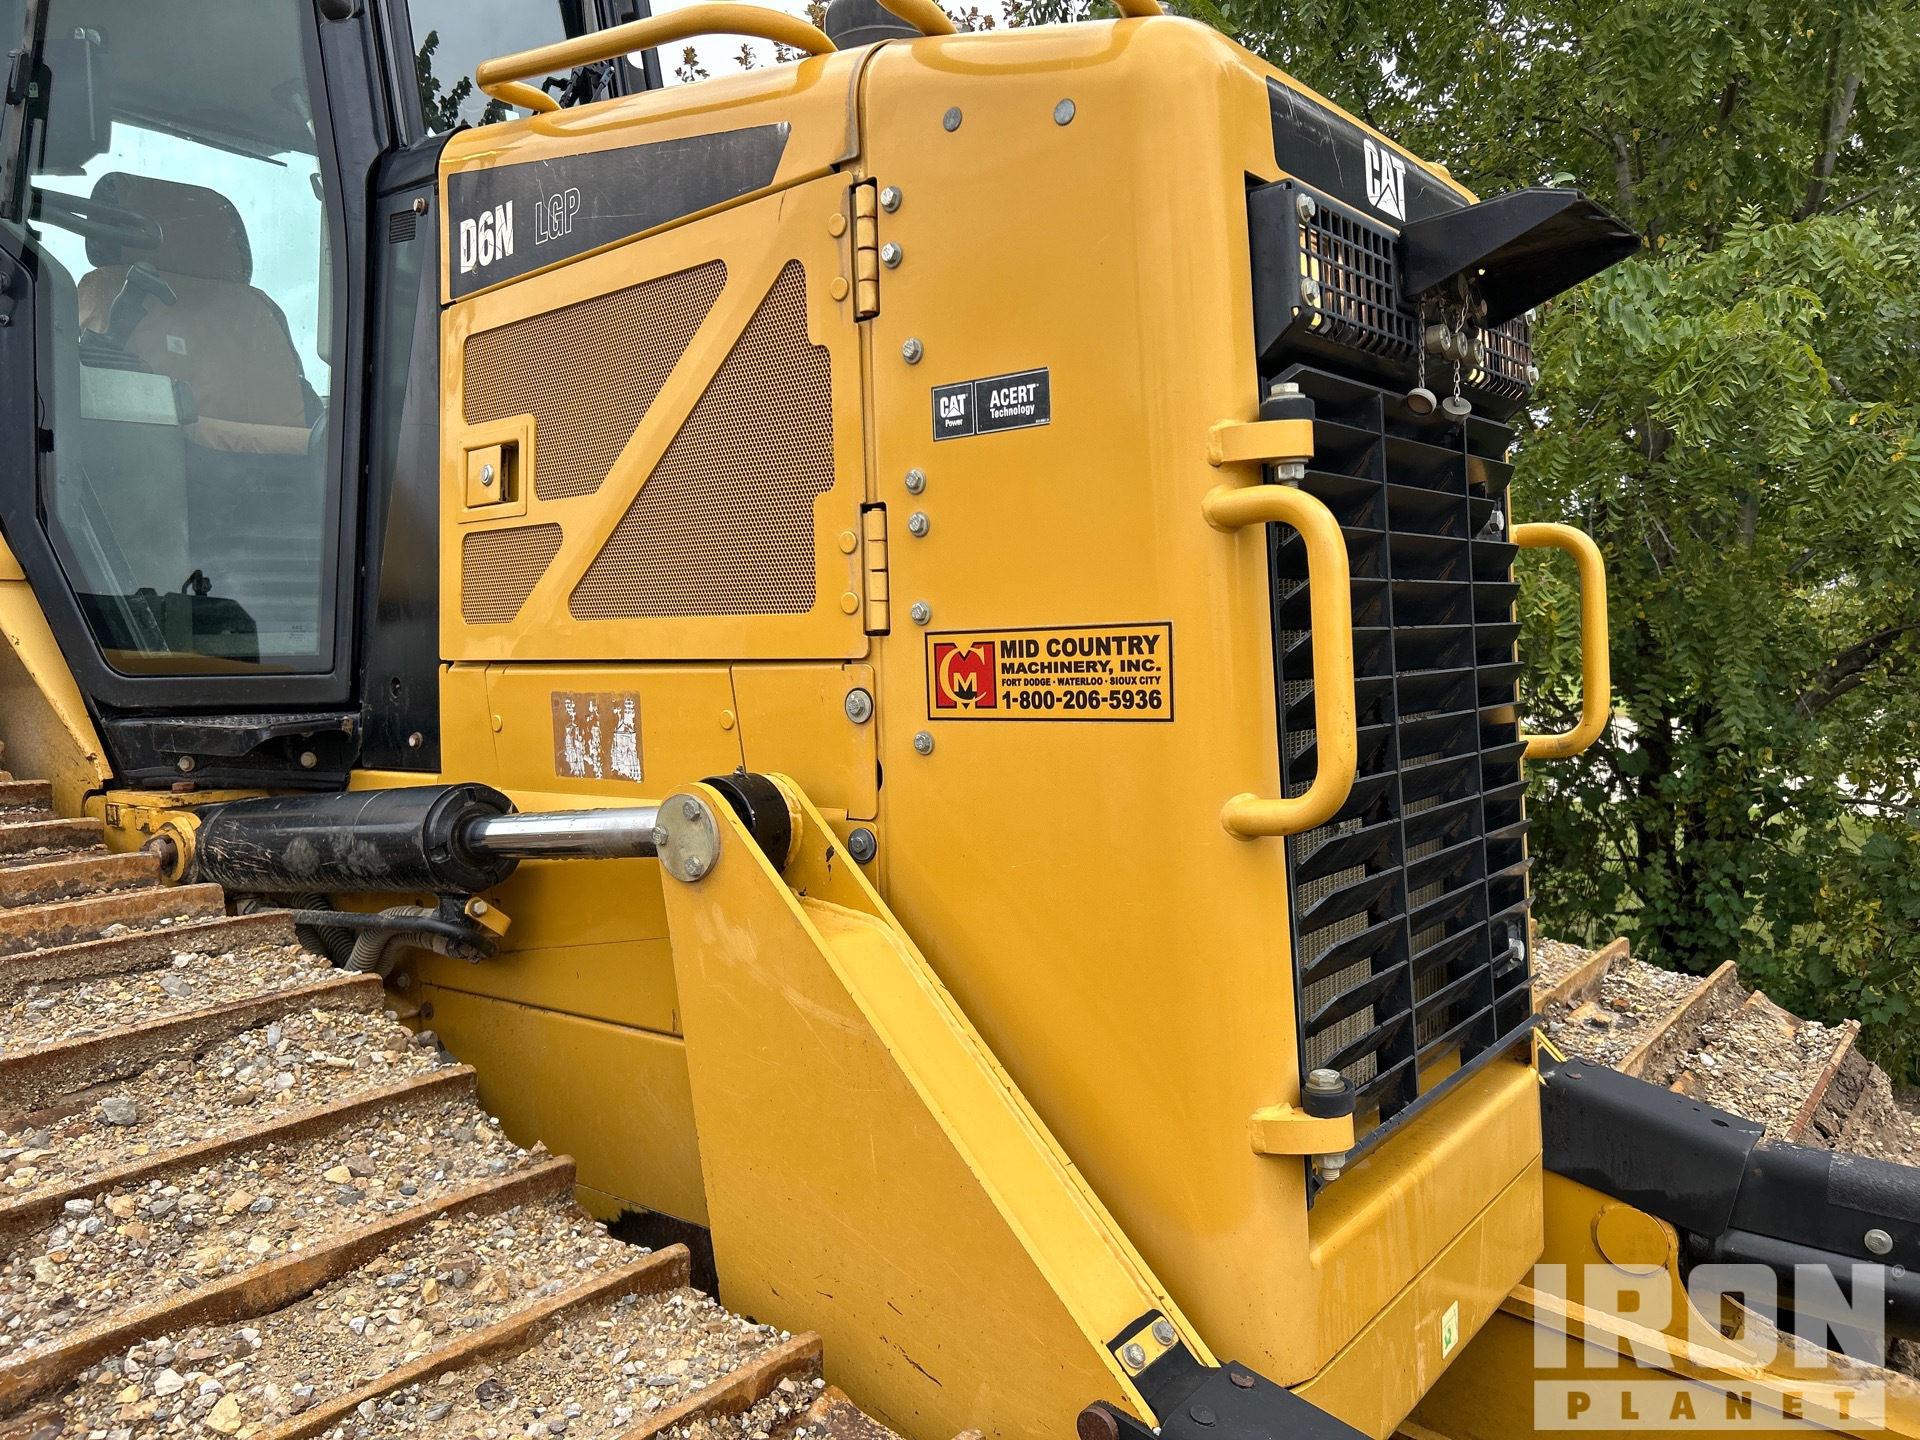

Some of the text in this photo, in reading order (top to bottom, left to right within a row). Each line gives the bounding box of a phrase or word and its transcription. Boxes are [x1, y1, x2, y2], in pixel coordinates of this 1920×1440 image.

[1363, 138, 1406, 222] CAT
[460, 187, 581, 274] D6N LGP
[940, 393, 966, 418] CAT
[990, 383, 1036, 408] ACERT
[990, 403, 1035, 419] Technology
[945, 418, 963, 428] Power
[1000, 634, 1160, 658] MID COUNTRY
[1001, 659, 1161, 675] MACHINERY, INC.
[1001, 676, 1161, 687] FORT DODGE WATERLOO SIOUX CITY
[1002, 690, 1162, 710] 1-800-206-5936
